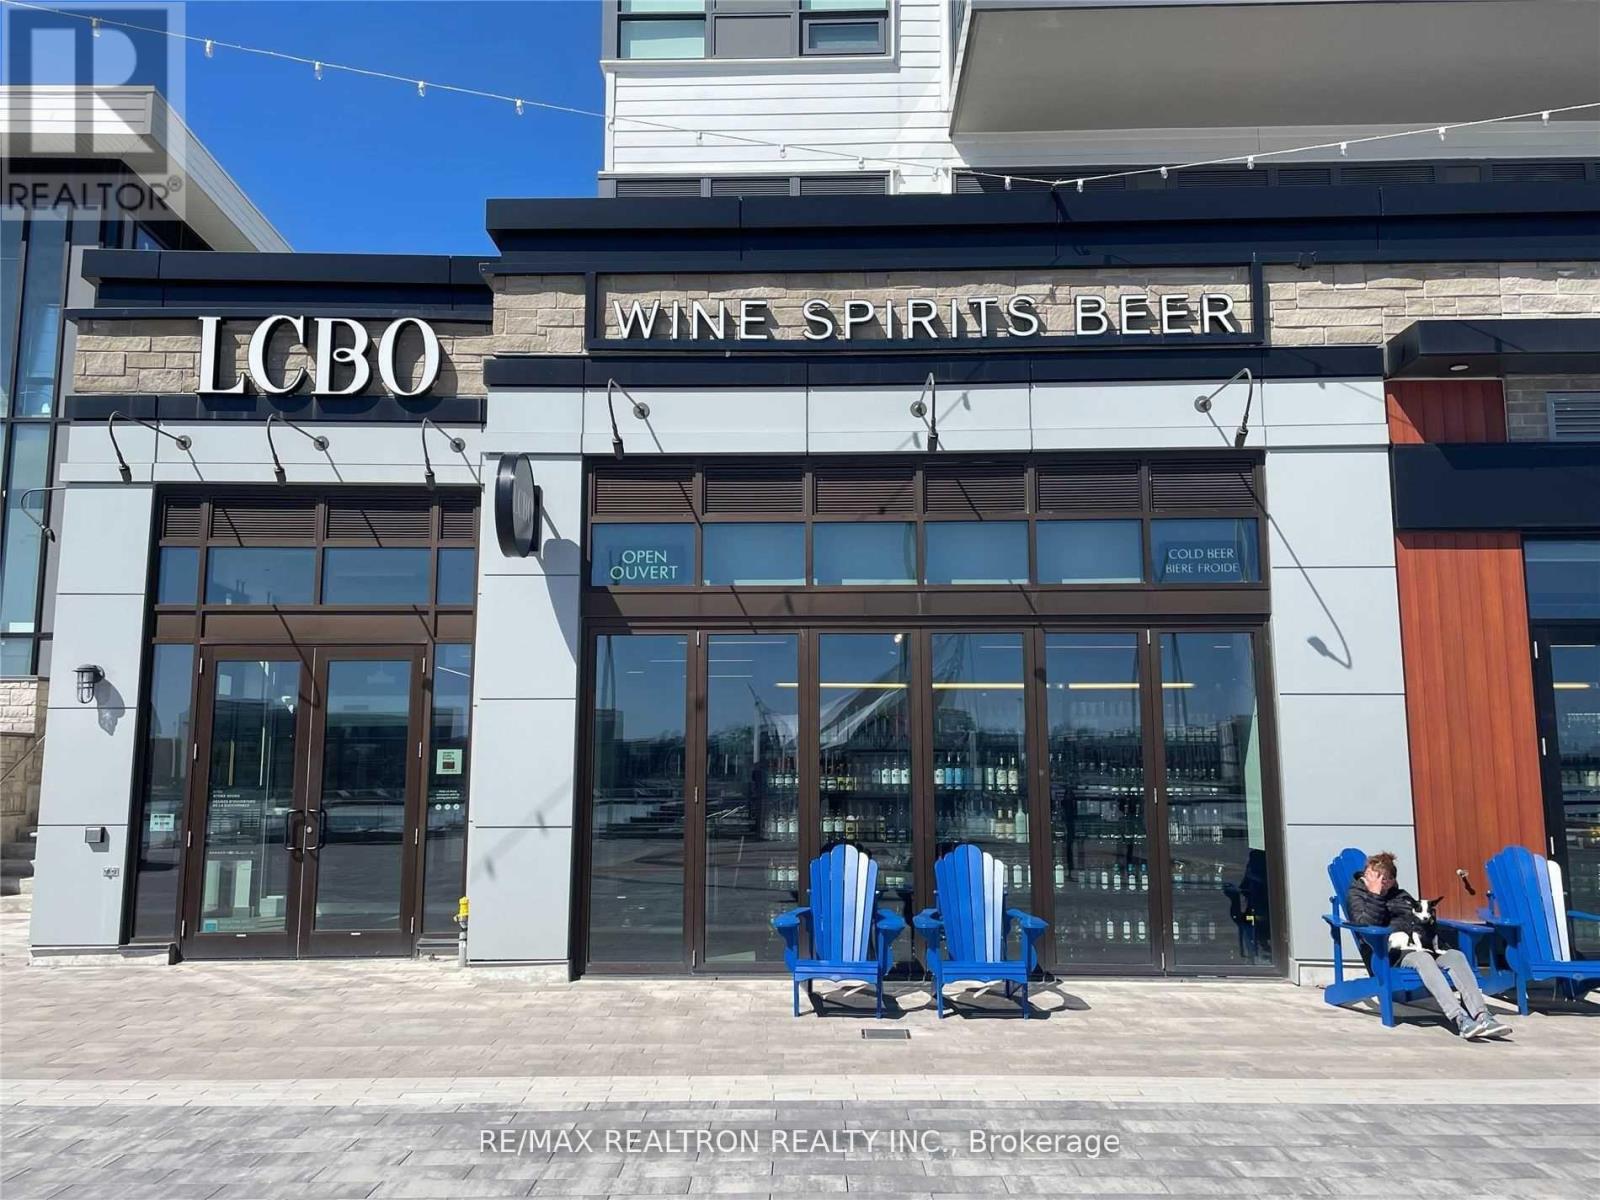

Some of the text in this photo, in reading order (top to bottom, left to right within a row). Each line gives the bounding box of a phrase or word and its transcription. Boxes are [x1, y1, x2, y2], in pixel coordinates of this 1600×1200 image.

[613, 293, 1236, 340] WINE SPIRITS BEER
[195, 315, 440, 396] LCBO
[622, 550, 667, 564] OPEN
[1168, 548, 1234, 560] COLD BEER
[610, 566, 679, 580] OUVERT
[1198, 562, 1240, 573] FROIDE
